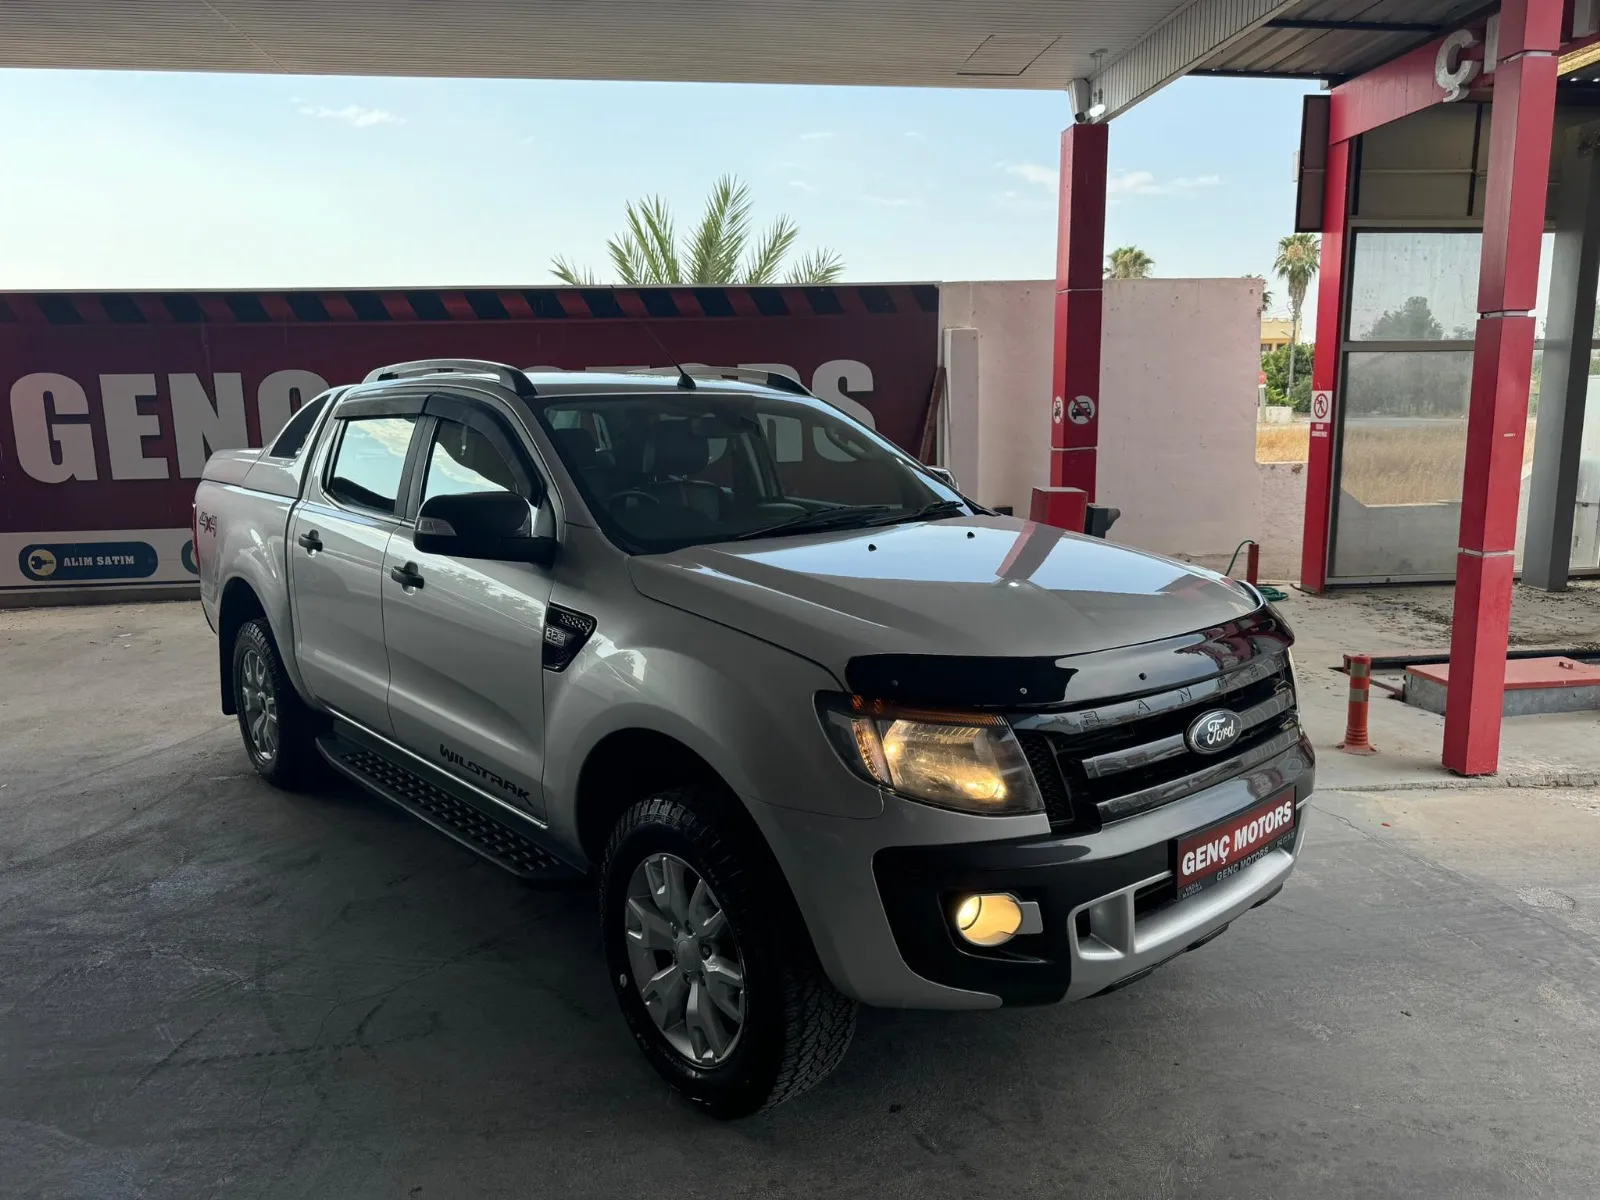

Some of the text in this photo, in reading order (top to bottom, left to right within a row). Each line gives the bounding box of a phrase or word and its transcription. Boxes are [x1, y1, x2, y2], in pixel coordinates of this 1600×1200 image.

[63, 556, 135, 567] ALIM SATIM
[1207, 717, 1236, 745] Ford
[440, 743, 533, 807] WILDTRAK
[1182, 800, 1292, 876] GENÇ MOTORS
